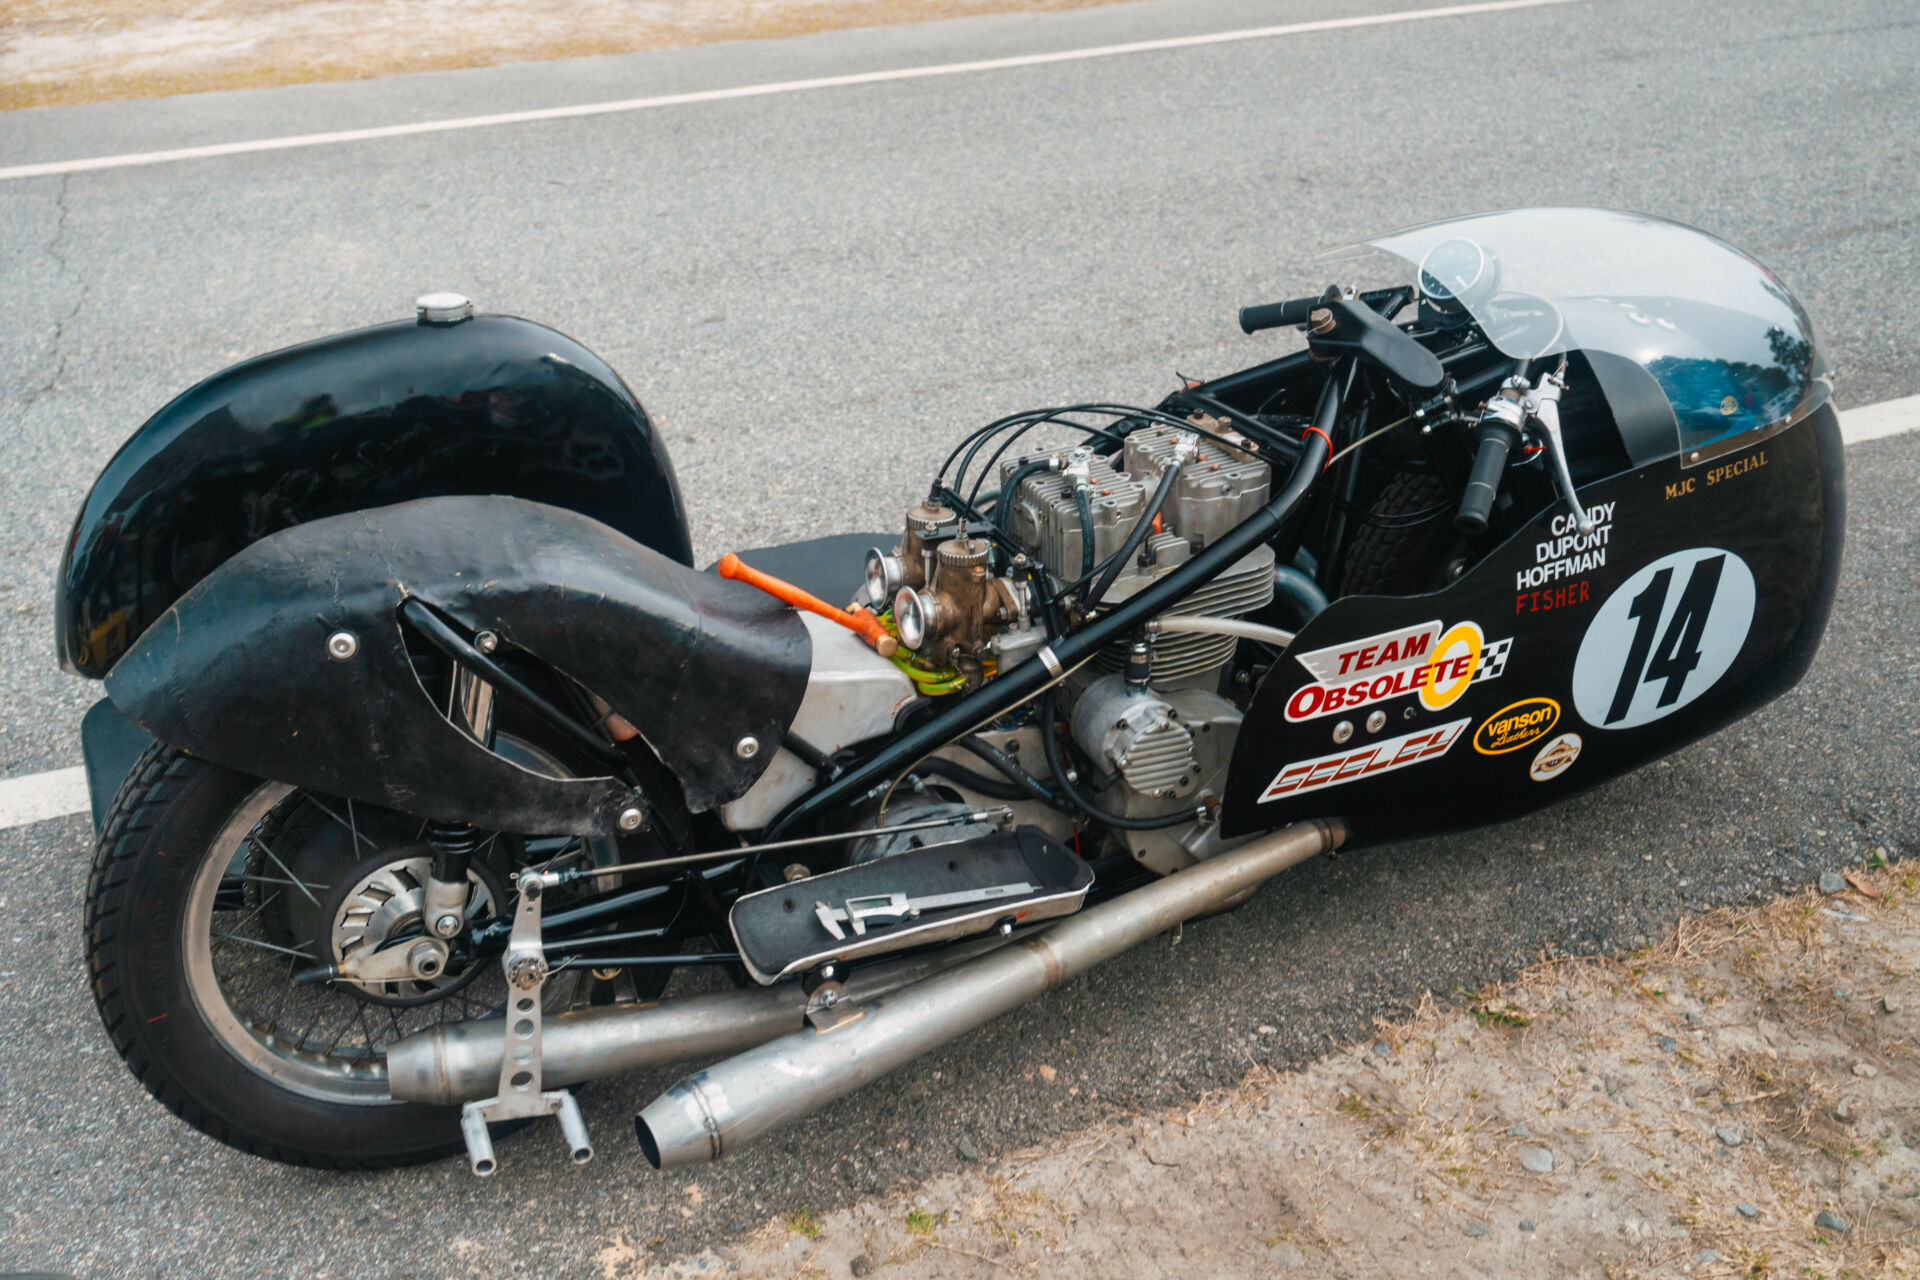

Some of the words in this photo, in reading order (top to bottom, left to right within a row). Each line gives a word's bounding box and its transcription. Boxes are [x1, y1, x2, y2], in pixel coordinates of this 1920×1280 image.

[1665, 477, 1696, 500] MJC
[1706, 451, 1768, 487] SPECIAL
[1536, 524, 1613, 563] DUPONT
[1516, 547, 1606, 591] HOFFMAN
[1516, 580, 1590, 615] FISHER
[1338, 632, 1432, 676] TEAM
[1603, 553, 1727, 726] 14
[1287, 653, 1474, 719] OBSOLETE
[1488, 705, 1552, 737] vanson
[1266, 724, 1464, 798] SEELEY
